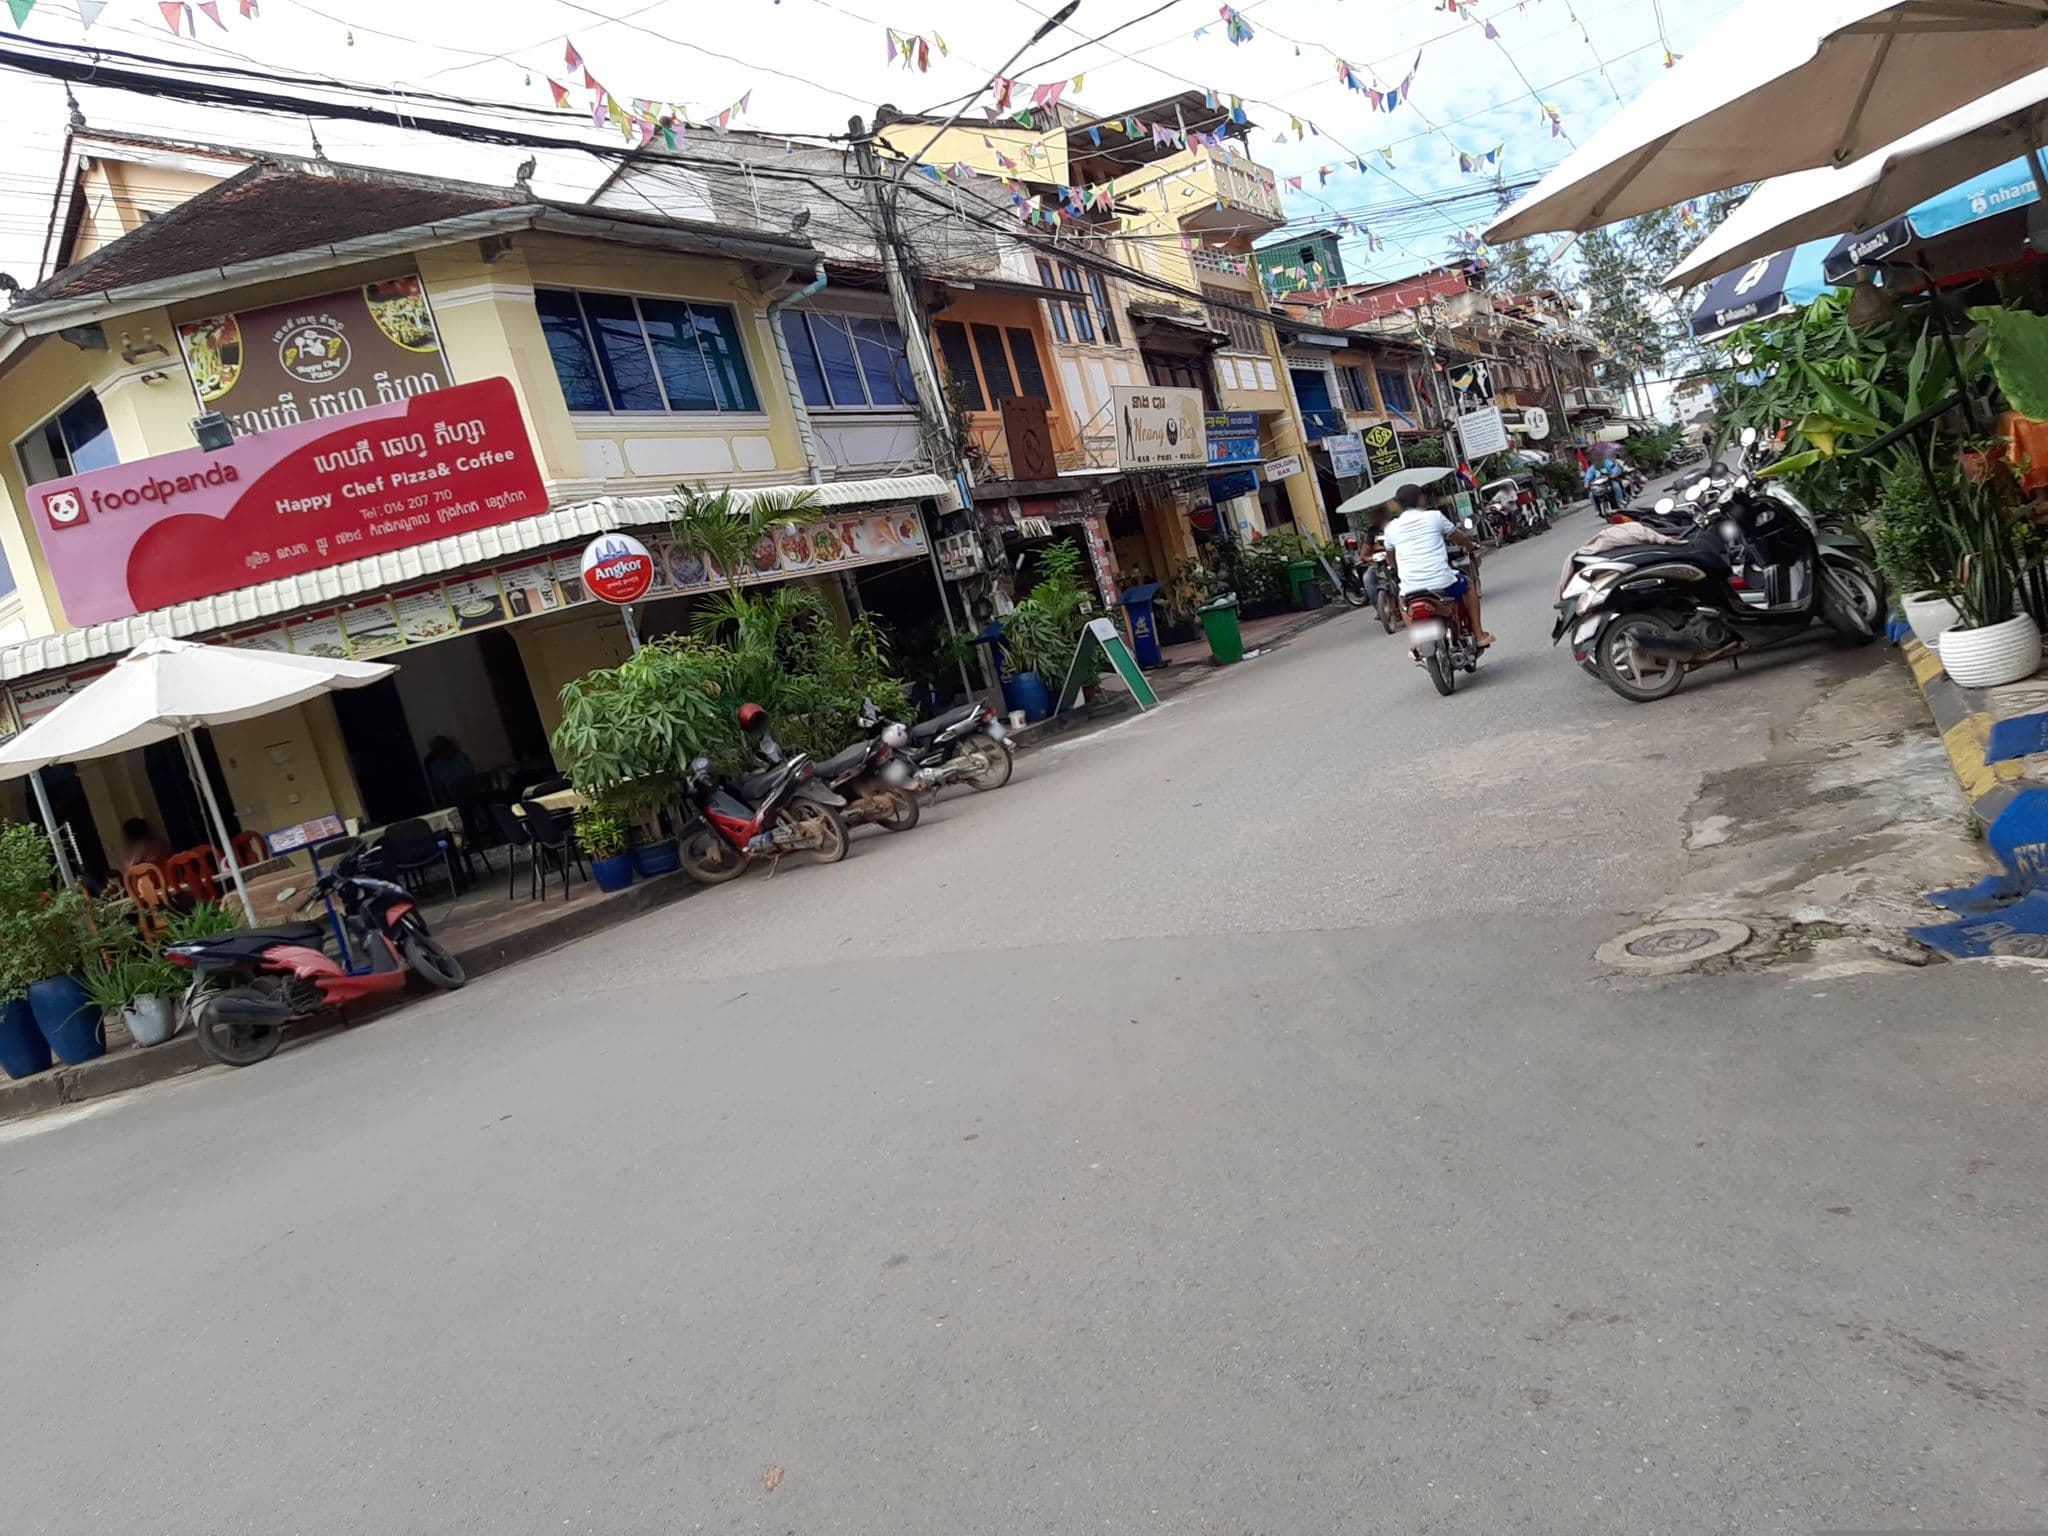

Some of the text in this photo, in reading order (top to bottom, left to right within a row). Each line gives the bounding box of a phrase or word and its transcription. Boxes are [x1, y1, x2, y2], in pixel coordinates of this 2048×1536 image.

[1134, 417, 1164, 447] Neang
[91, 461, 239, 513] foodpanda
[275, 492, 332, 514] Happy
[342, 474, 384, 499] Chef
[456, 449, 515, 472] Coffee
[383, 500, 405, 515] 016
[408, 494, 430, 509] 207
[432, 489, 453, 503] 710
[595, 559, 642, 581] Angkor
